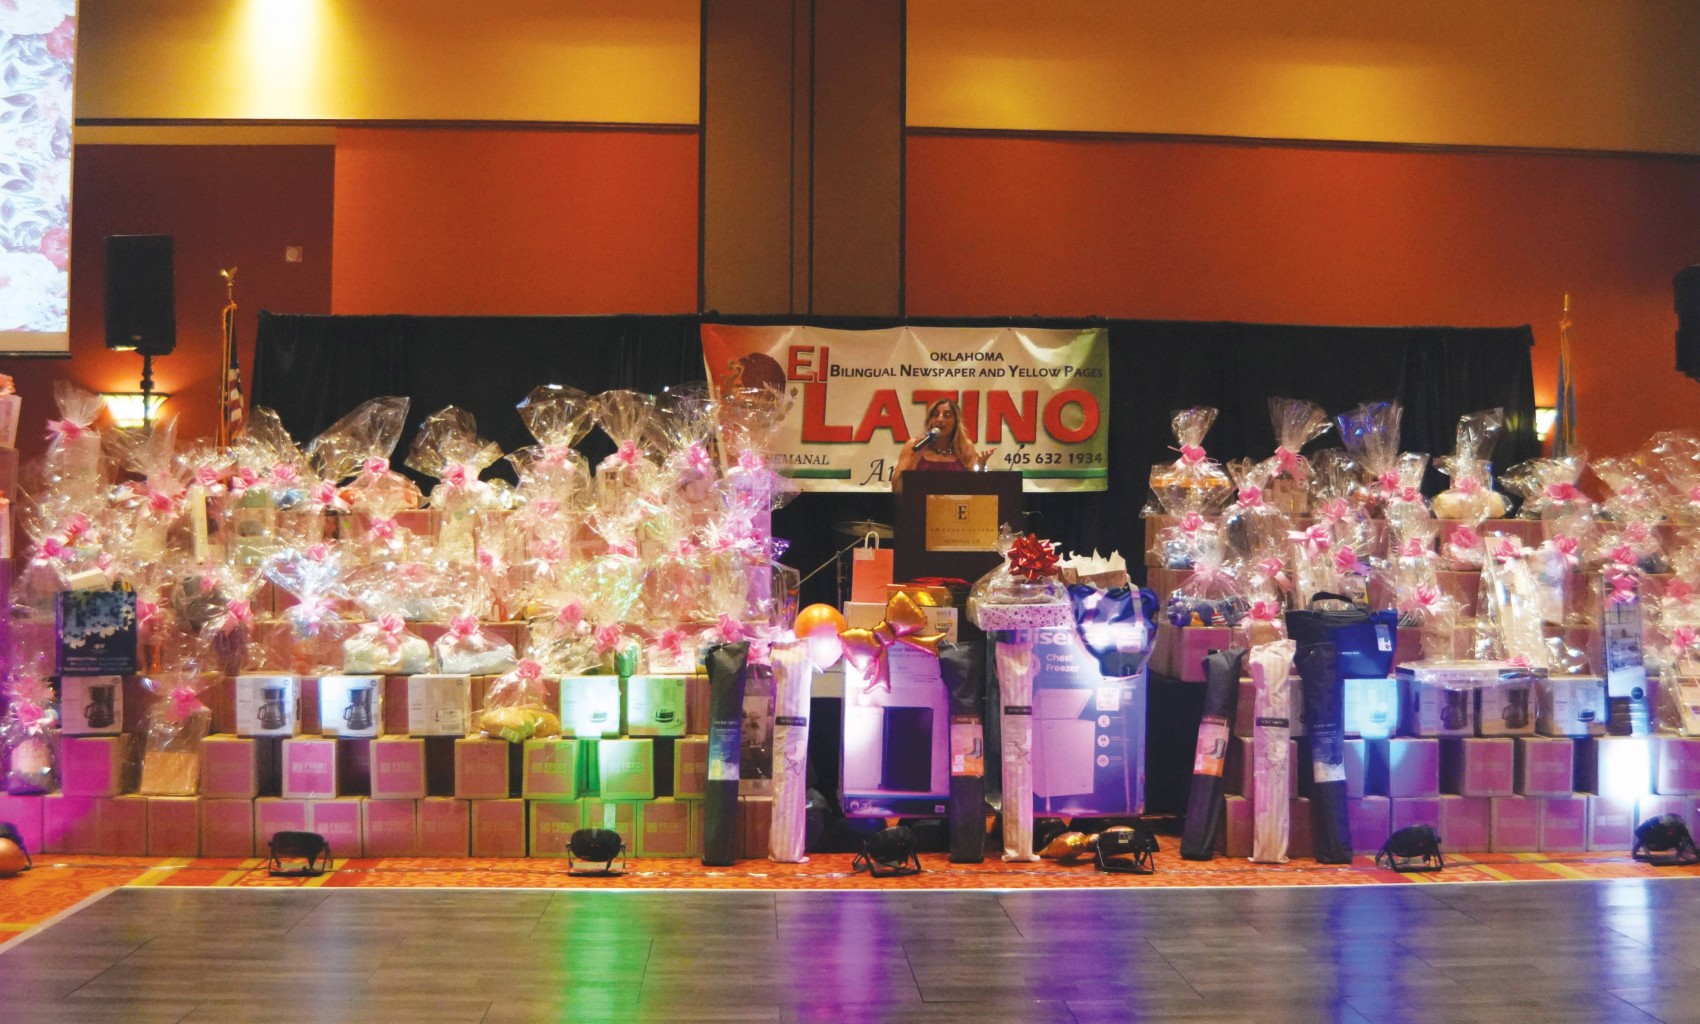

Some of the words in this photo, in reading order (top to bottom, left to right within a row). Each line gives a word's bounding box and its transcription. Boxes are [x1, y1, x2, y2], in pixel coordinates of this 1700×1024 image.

[786, 345, 829, 382] El
[930, 352, 1004, 362] OKLAHOMA
[830, 364, 897, 378] BILINGUAL
[900, 364, 976, 378] NEWSPAPER
[979, 367, 1005, 378] AND
[1008, 365, 1061, 378] YELLOW
[1064, 367, 1104, 378] PAGES
[800, 388, 1100, 444] LATINO
[766, 453, 830, 466] SEMANAL
[1004, 453, 1031, 464] 405
[1035, 453, 1062, 464] 632
[1068, 453, 1103, 464] 1934
[958, 505, 967, 520] E
[1046, 653, 1073, 662] Chest
[1046, 664, 1080, 673] Freezer
